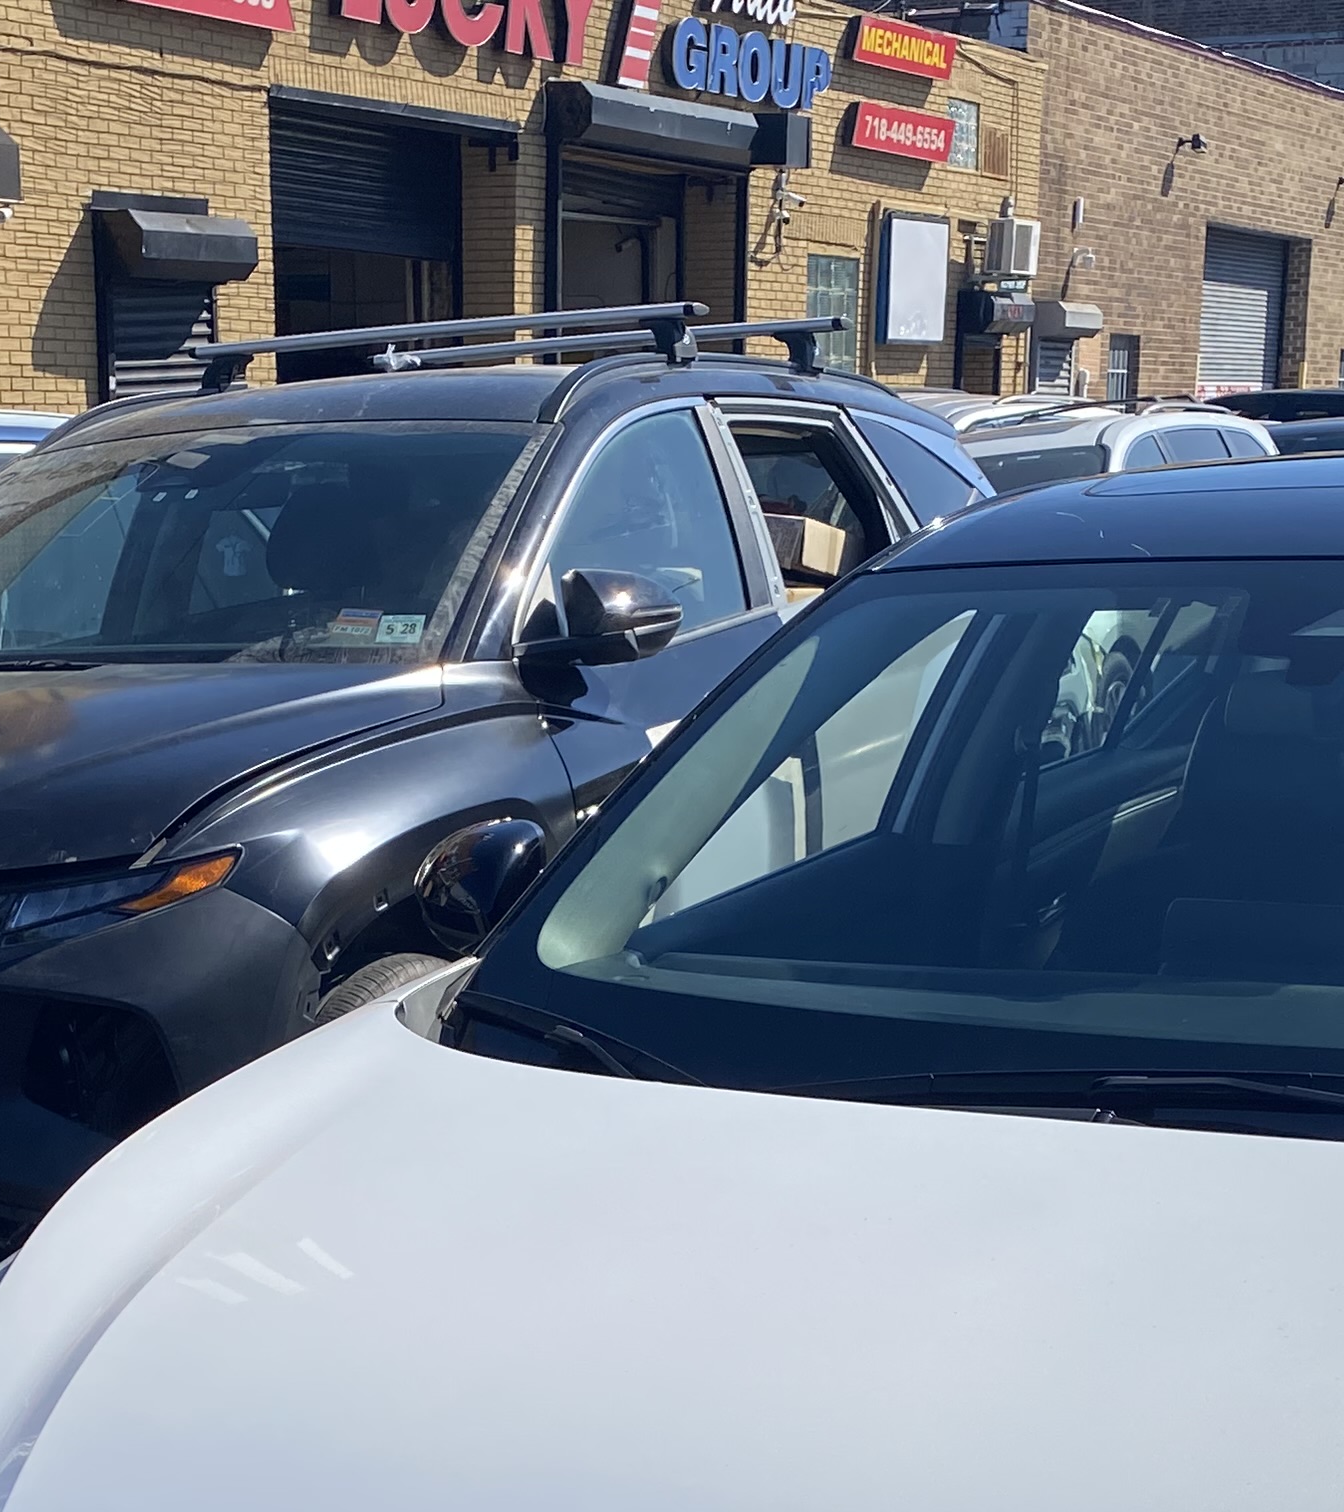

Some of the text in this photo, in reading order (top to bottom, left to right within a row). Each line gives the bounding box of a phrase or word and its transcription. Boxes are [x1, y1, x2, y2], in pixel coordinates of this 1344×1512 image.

[672, 16, 832, 110] GROUP
[861, 25, 948, 70] MECHANICAL
[864, 114, 946, 153] 718-449-6554
[385, 622, 417, 635] 5 28
